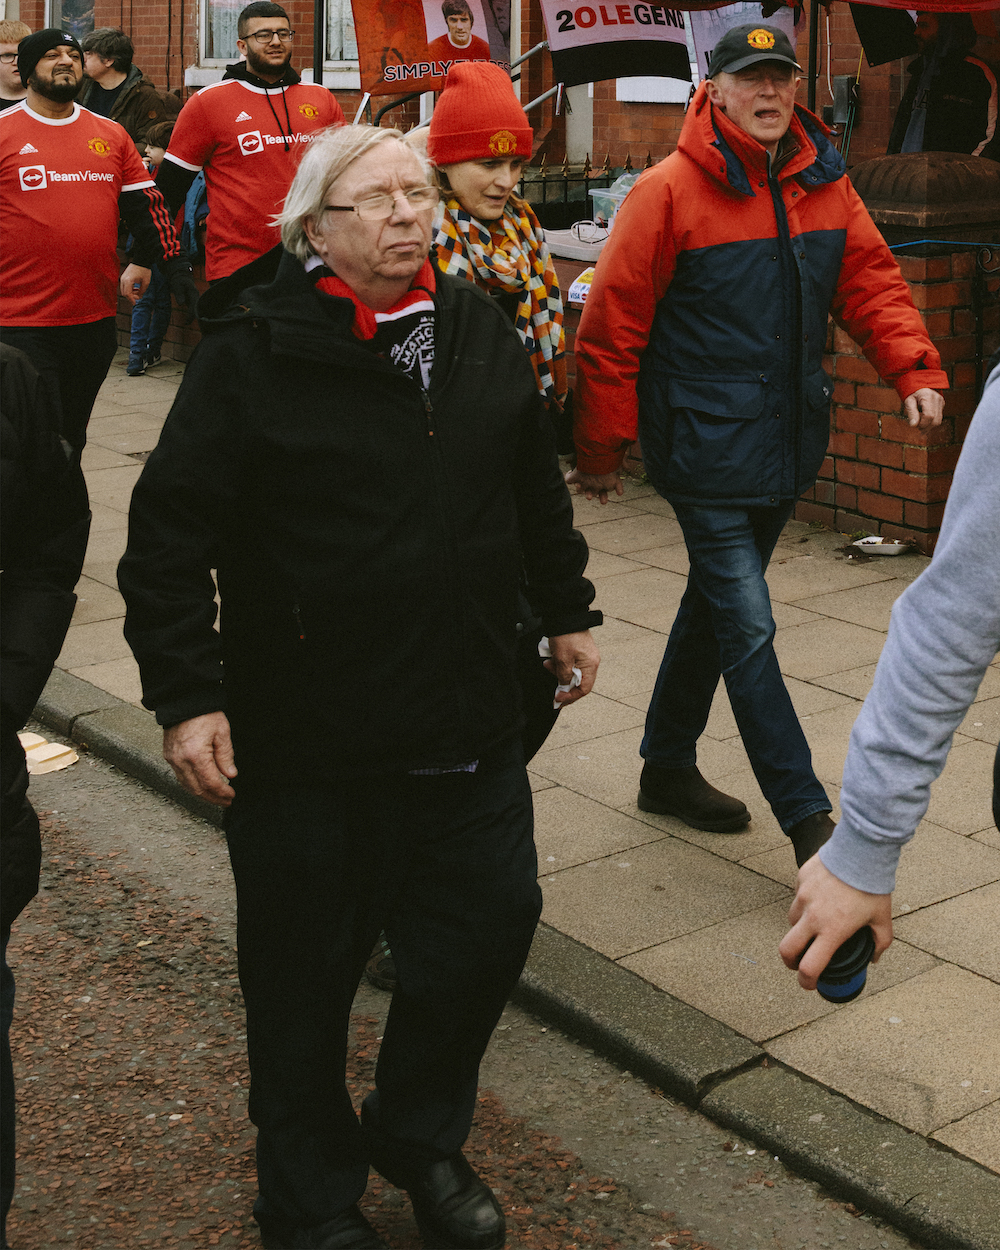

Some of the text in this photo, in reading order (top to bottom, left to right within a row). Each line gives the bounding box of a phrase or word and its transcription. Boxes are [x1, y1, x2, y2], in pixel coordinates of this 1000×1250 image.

[384, 61, 452, 82] SIMPLY
[262, 132, 318, 145] TeamView
[47, 170, 114, 183] TeamViewer
[570, 292, 581, 300] VISA
